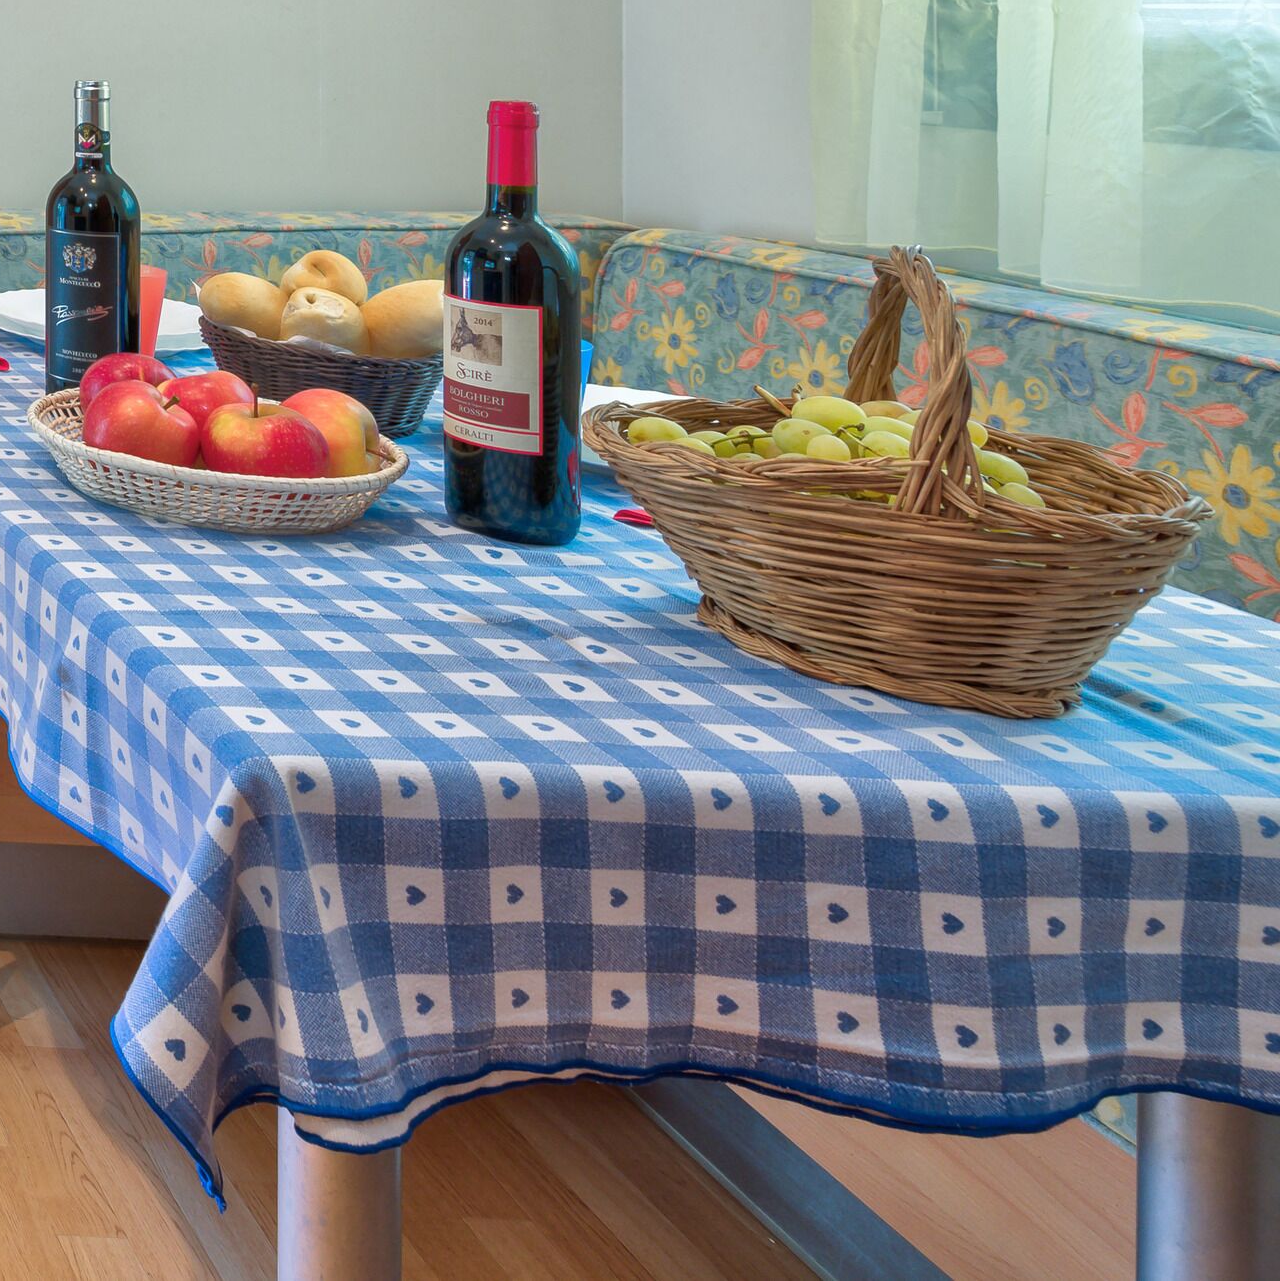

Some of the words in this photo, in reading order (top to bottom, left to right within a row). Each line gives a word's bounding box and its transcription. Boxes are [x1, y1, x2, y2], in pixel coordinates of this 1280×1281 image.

[473, 317, 493, 326] 2014
[456, 361, 493, 382] SCIRÈ
[449, 385, 505, 406] BOLGHERI
[458, 404, 489, 418] ROSSO
[454, 425, 494, 442] CERALTI
